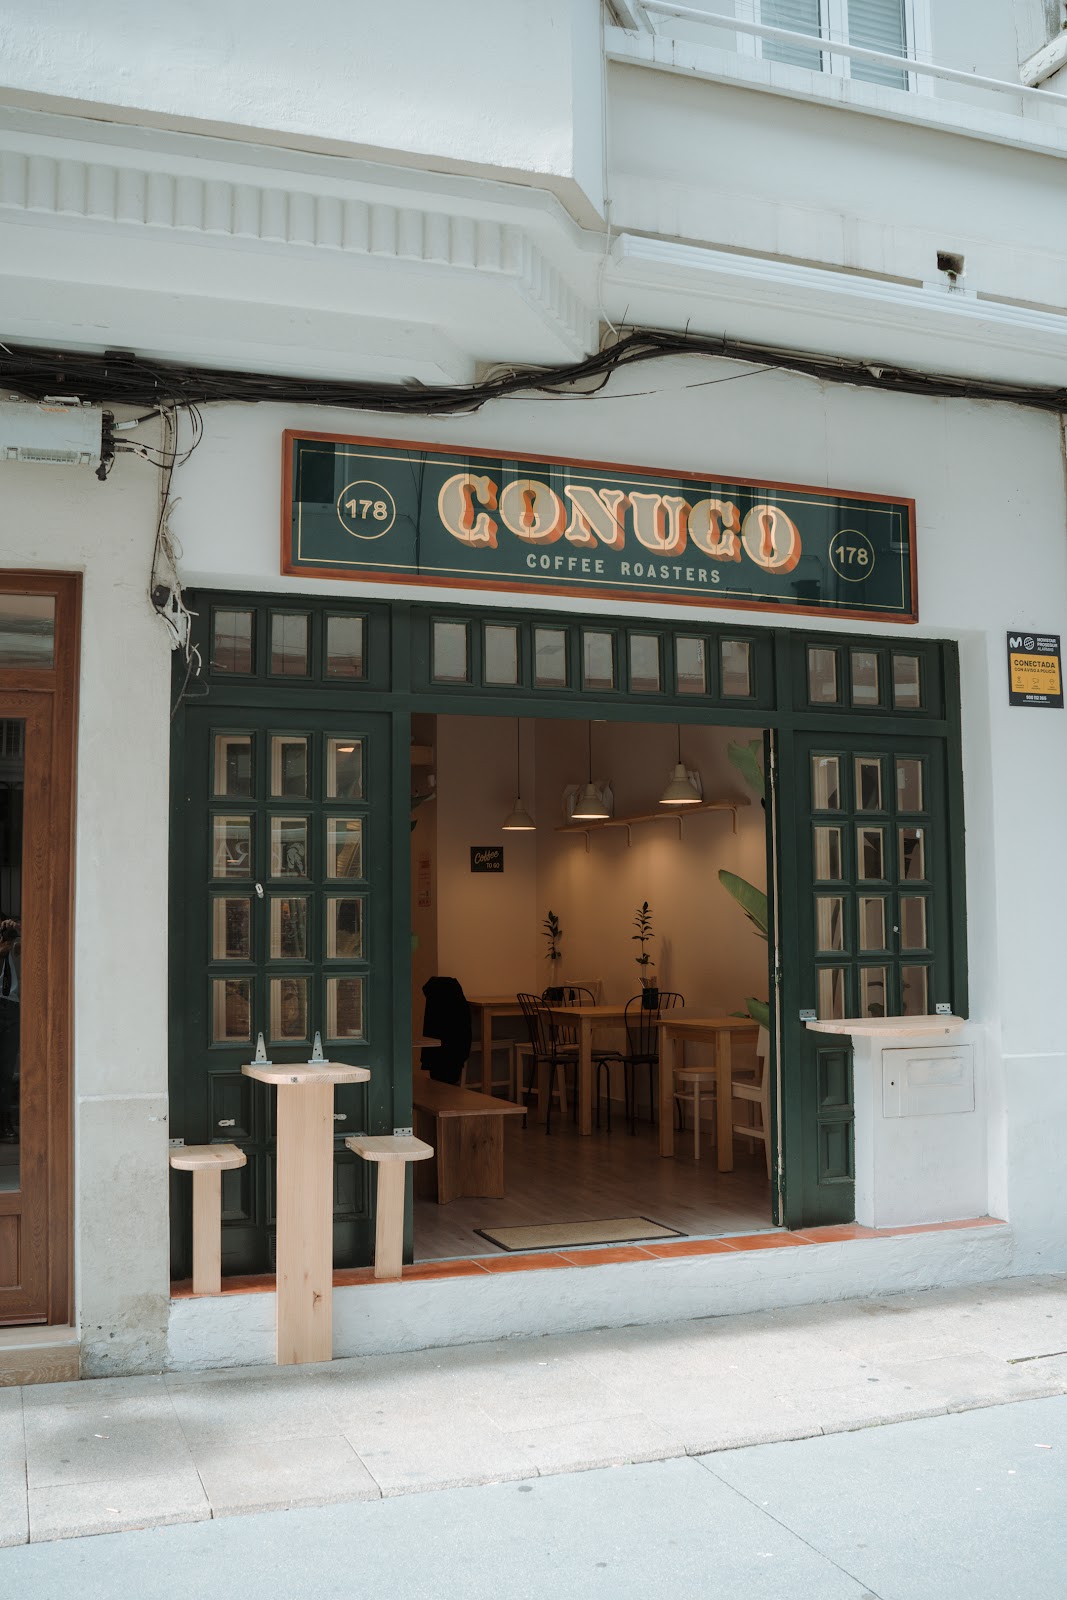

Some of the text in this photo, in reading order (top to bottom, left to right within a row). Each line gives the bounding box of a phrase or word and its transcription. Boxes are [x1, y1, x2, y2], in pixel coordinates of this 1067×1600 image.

[344, 499, 388, 521] 178
[437, 473, 802, 575] CONUCO
[835, 545, 869, 566] 178
[526, 553, 721, 584] COFFEE ROASTERS
[1014, 660, 1055, 668] CONECTADA
[475, 850, 499, 864] Coffee
